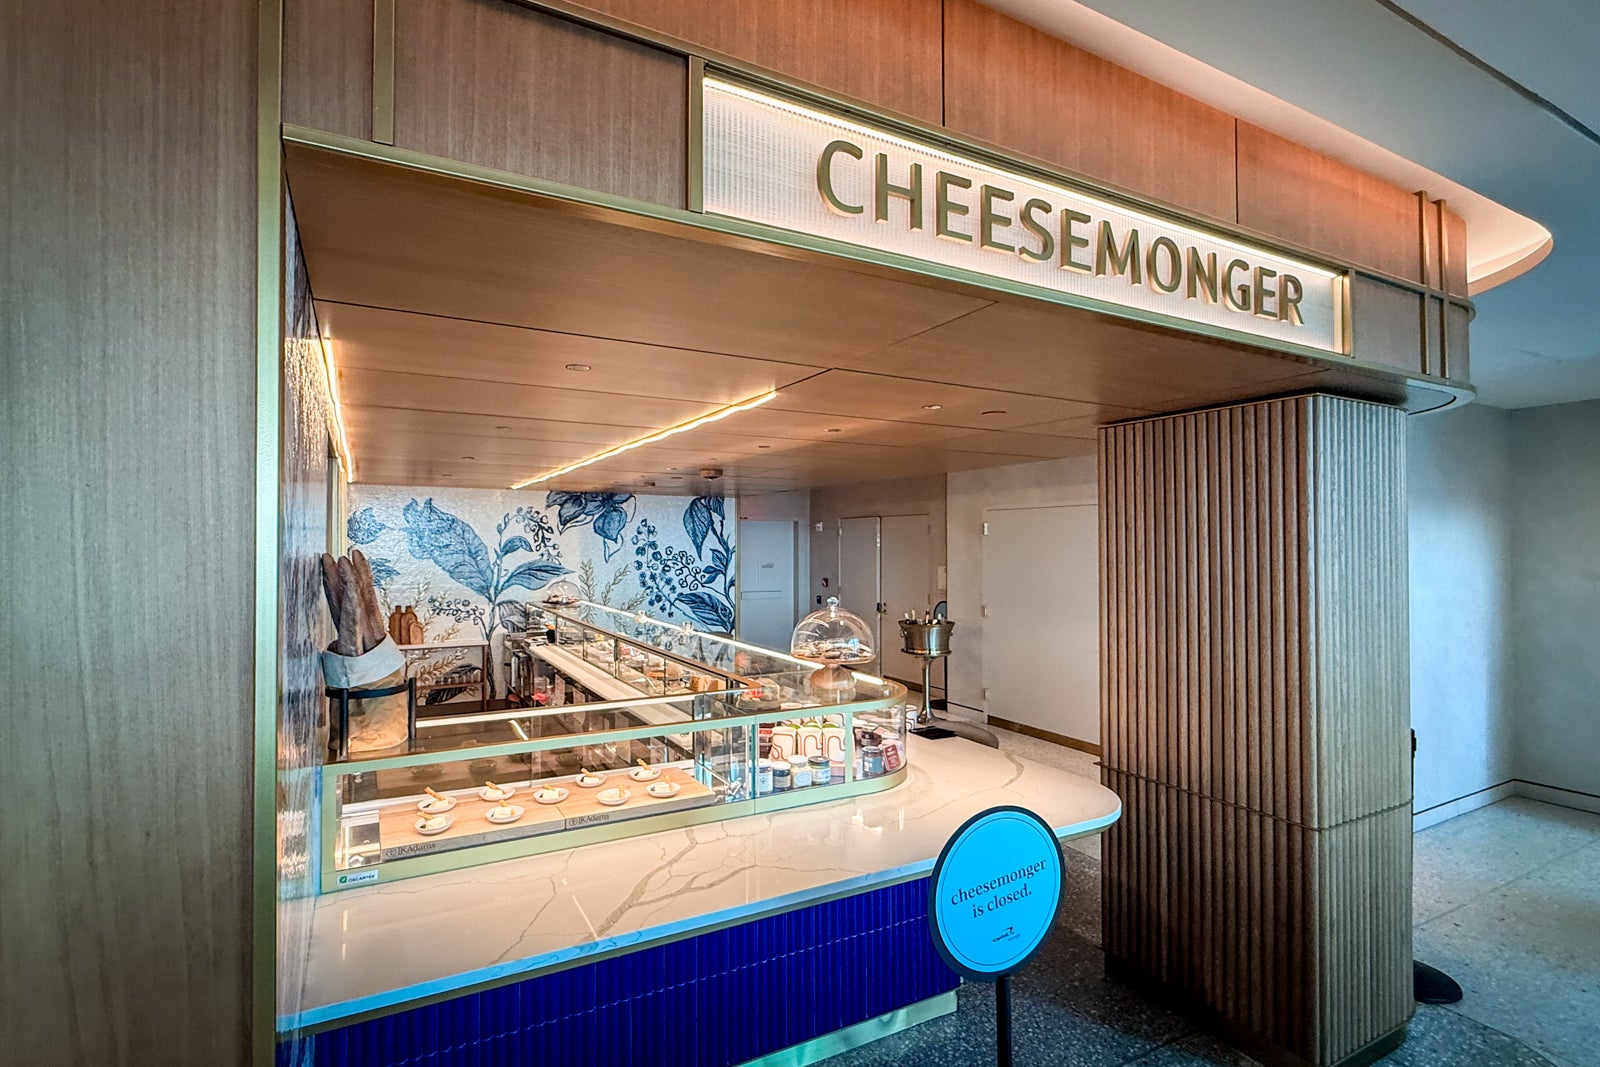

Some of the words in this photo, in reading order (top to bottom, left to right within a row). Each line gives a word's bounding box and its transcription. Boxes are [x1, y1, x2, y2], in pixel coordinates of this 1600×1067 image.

[816, 140, 1304, 327] CHEESEMONGER
[951, 859, 1047, 905] cheesemonger
[972, 904, 984, 918] is
[987, 883, 1032, 911] closed.
